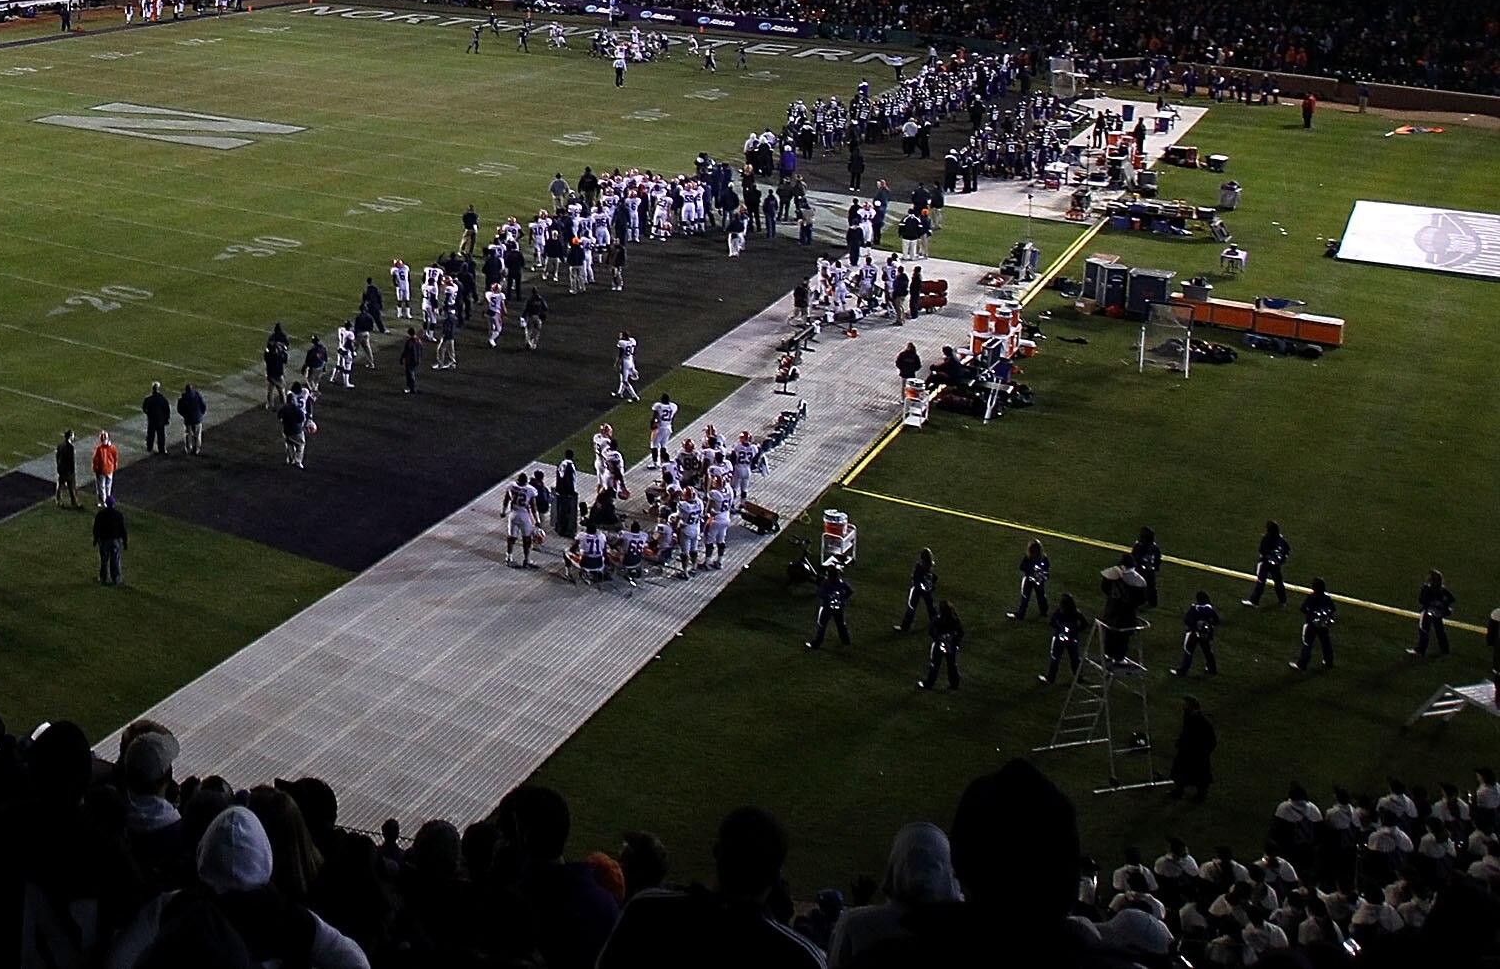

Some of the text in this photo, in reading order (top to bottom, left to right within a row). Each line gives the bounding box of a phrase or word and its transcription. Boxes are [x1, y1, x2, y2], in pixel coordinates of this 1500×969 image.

[709, 18, 736, 27] Allstate
[770, 24, 799, 33] Allstate
[358, 195, 423, 214] 40
[227, 235, 303, 259] 30
[64, 284, 154, 314] 20
[661, 409, 673, 422] 21
[738, 451, 753, 465] 23
[586, 539, 600, 555] 71
[628, 539, 644, 553] 66
